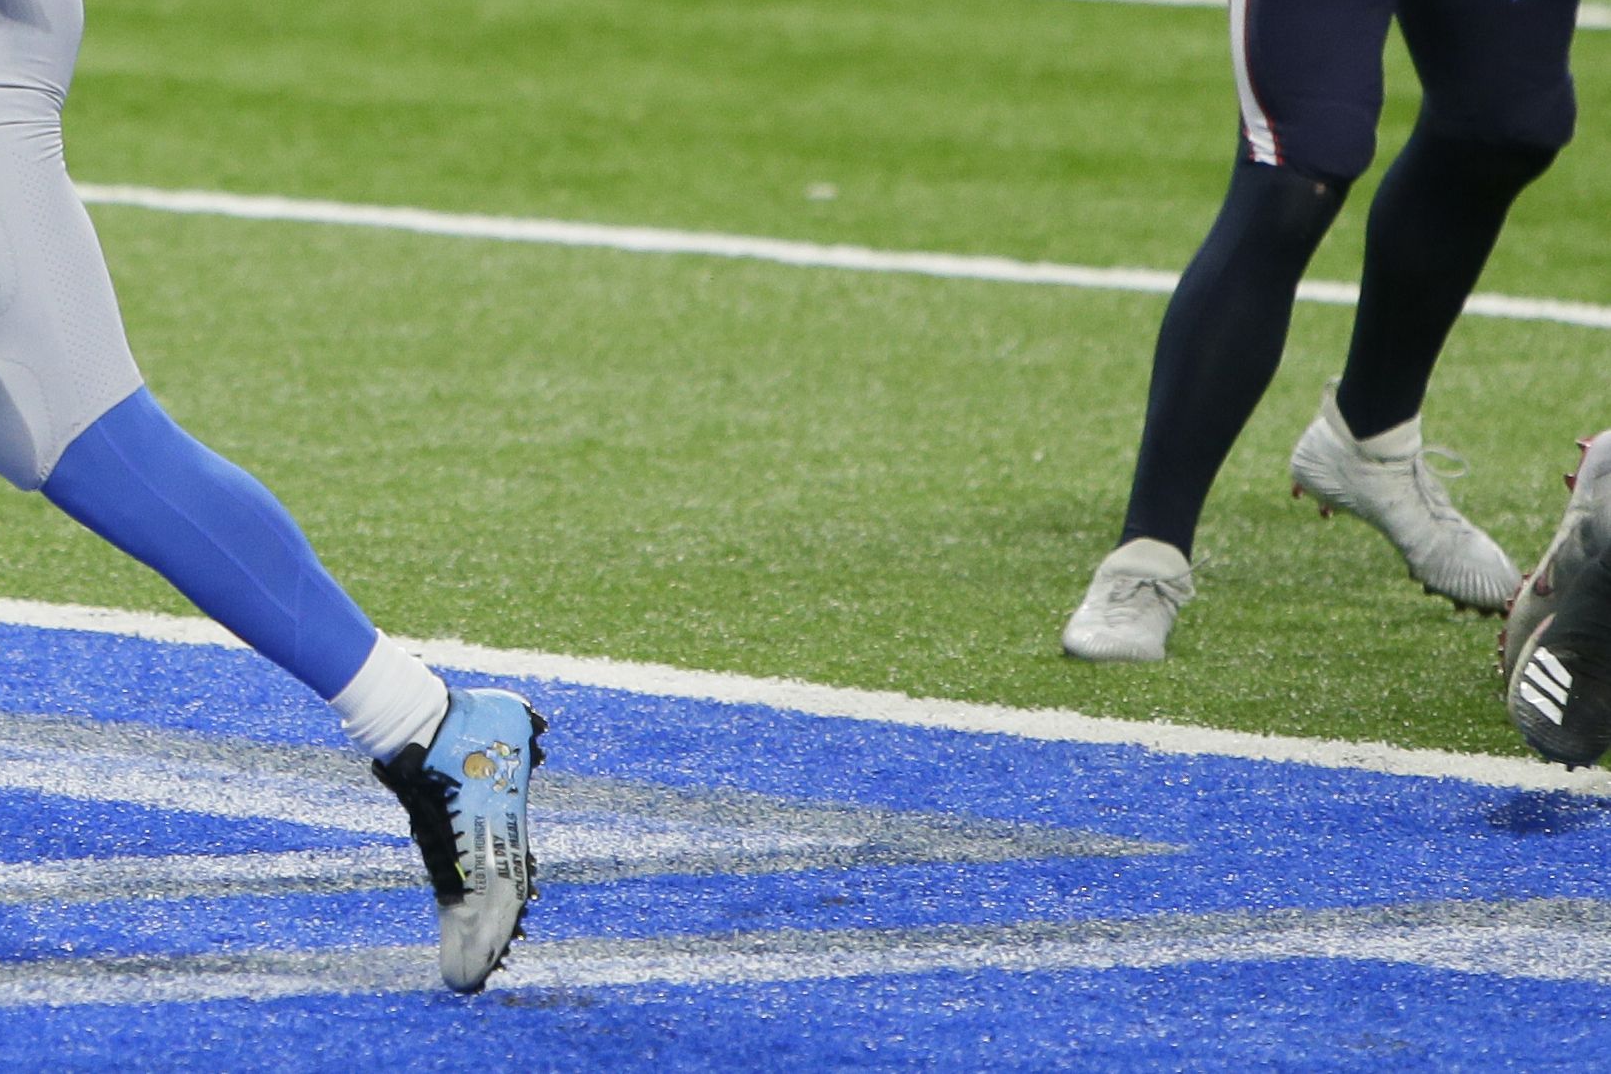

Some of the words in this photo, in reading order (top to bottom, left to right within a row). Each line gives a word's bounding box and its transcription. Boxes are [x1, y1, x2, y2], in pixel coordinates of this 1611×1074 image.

[474, 815, 486, 852] HUNGRY
[492, 834, 506, 857] DAY
[506, 812, 520, 849] MEALS
[475, 853, 486, 871] THE
[497, 859, 510, 879] ALL
[511, 852, 525, 901] HOLIDAY
